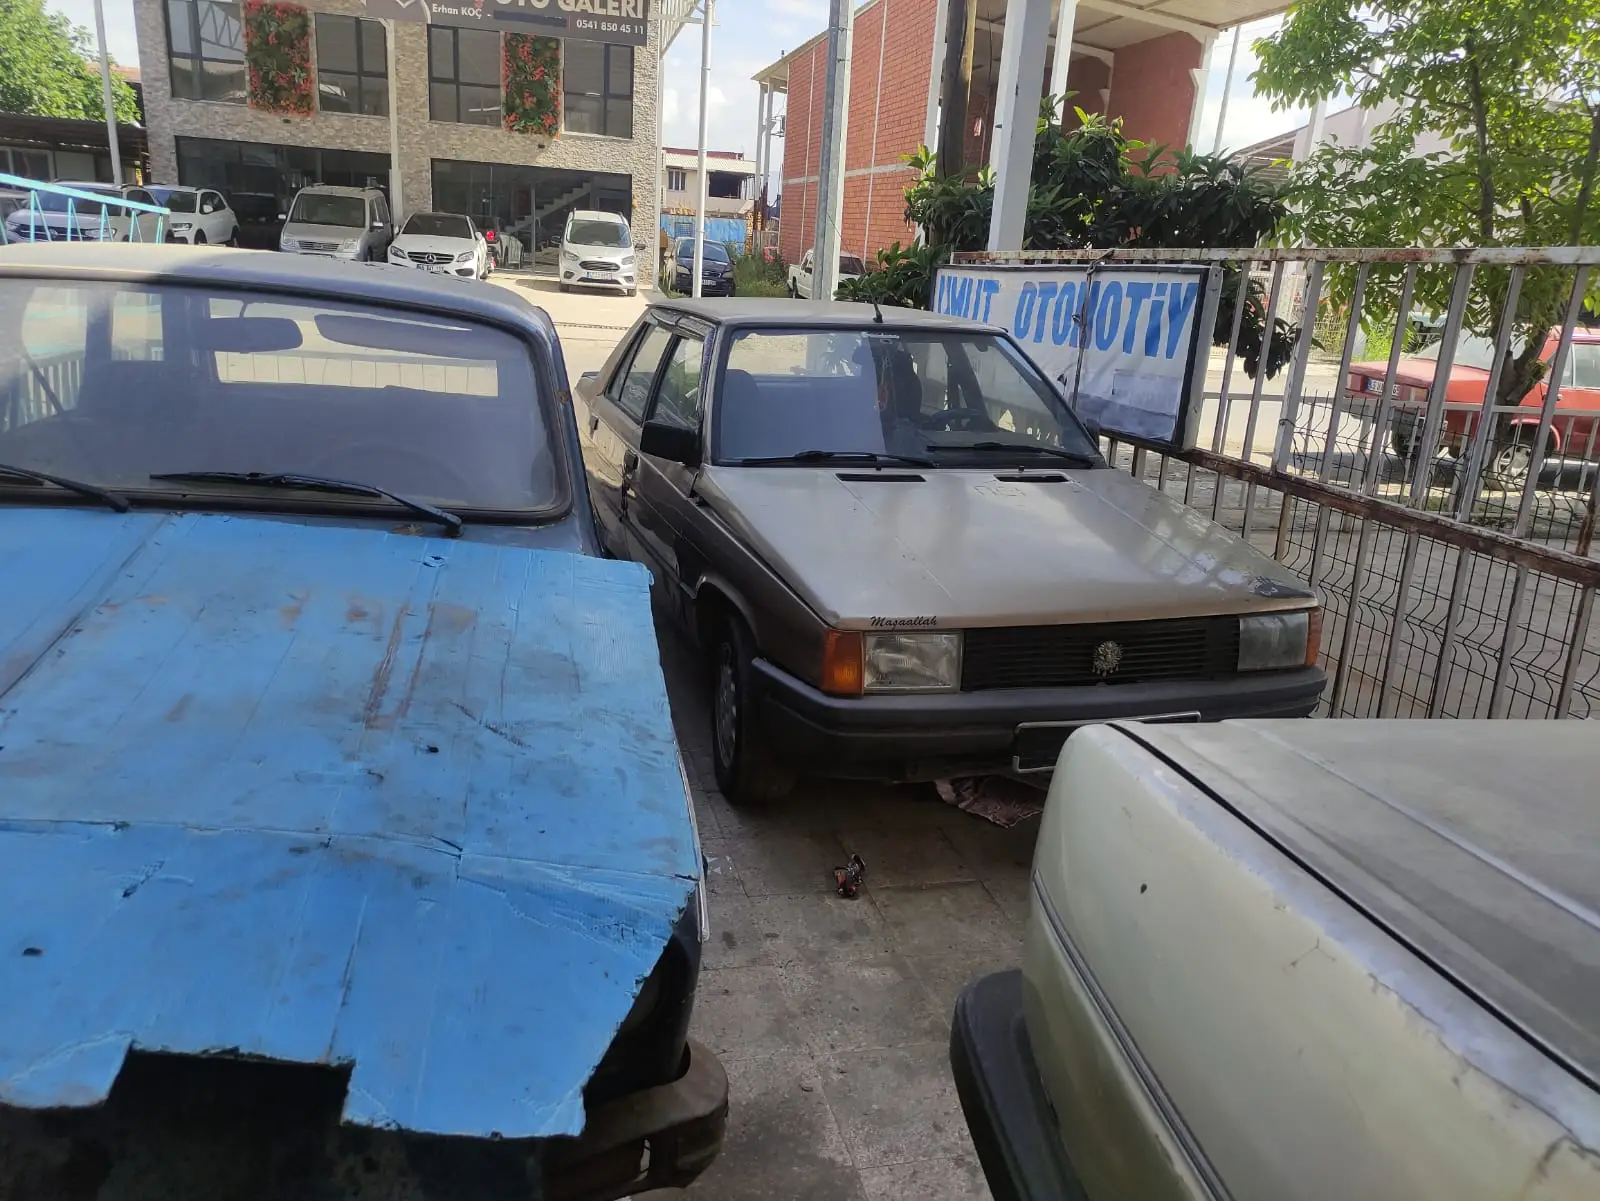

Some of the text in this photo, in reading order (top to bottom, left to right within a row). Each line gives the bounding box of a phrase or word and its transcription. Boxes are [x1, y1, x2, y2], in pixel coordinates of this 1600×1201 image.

[432, 3, 482, 20] Erhan KOÇ
[576, 19, 644, 35] 0541 850 45 11
